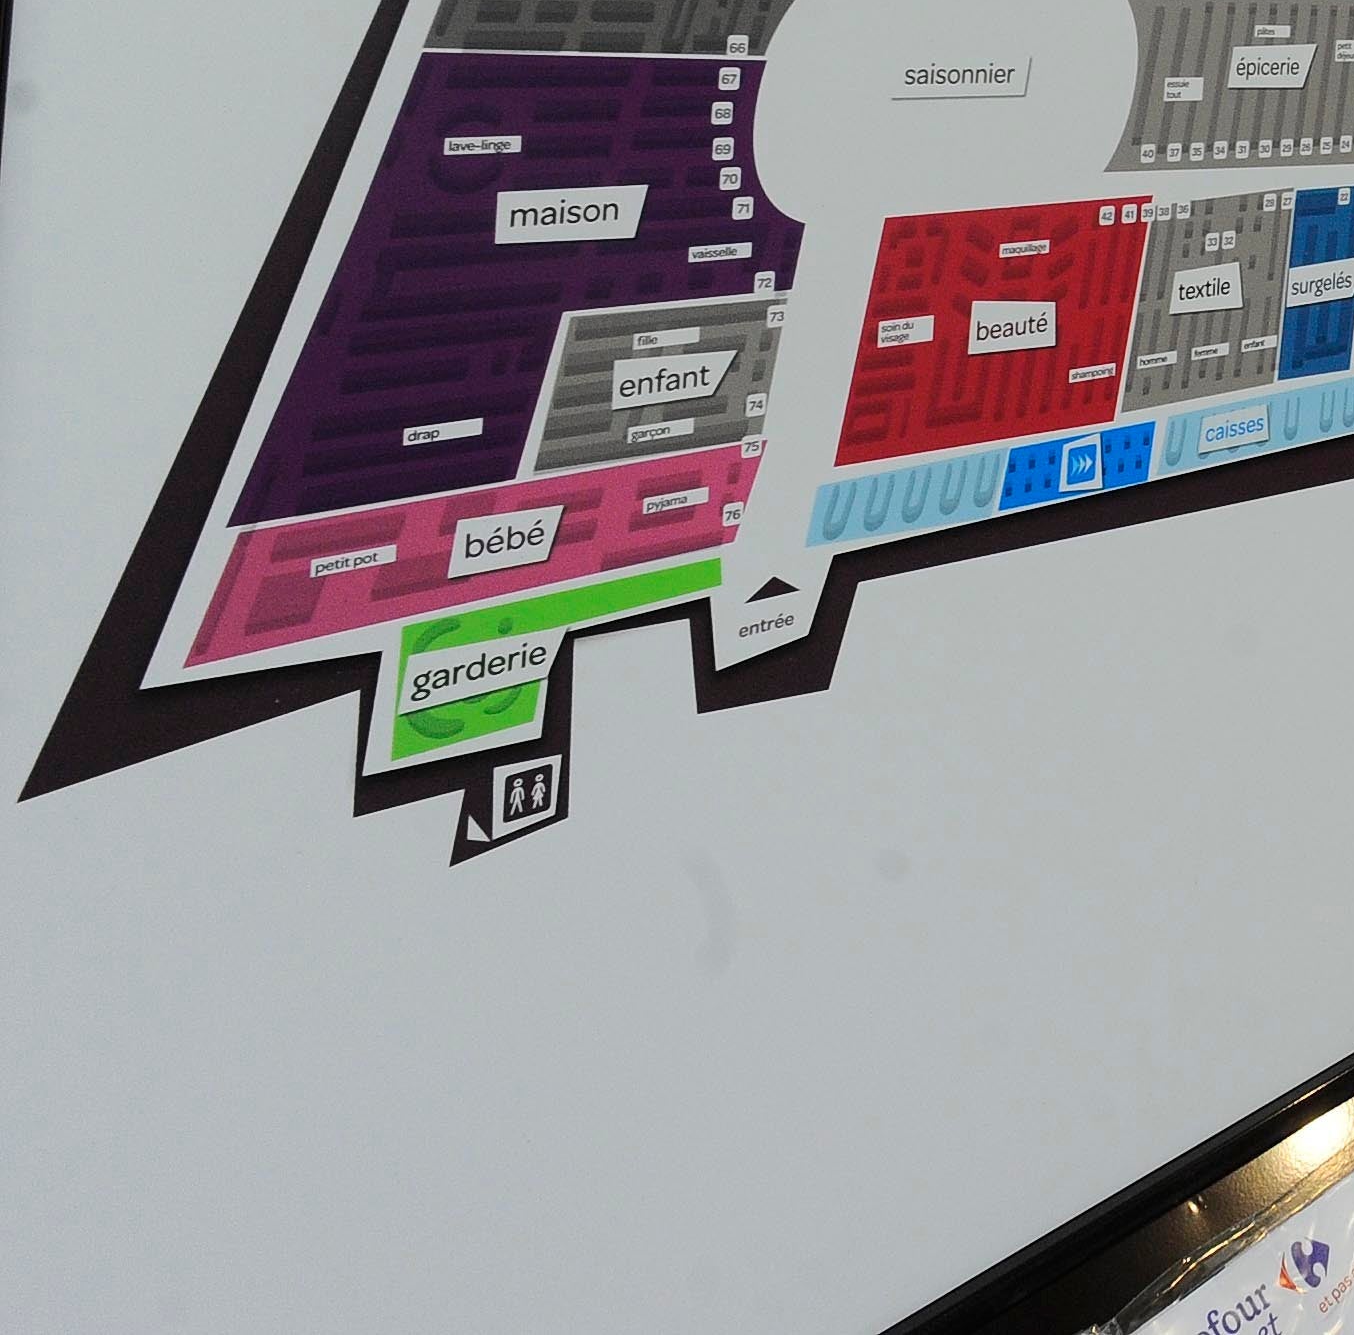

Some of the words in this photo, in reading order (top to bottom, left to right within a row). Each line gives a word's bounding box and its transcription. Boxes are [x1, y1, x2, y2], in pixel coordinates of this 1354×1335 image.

[729, 42, 746, 54] 66
[904, 61, 1016, 85] saisonnier
[1236, 57, 1300, 81] épicerie
[721, 74, 738, 85] 67
[714, 108, 732, 120] 68
[448, 139, 512, 153] lave-linge
[714, 144, 732, 155] 69
[722, 173, 739, 185] 70
[509, 198, 619, 228] maison
[737, 203, 750, 214] 71
[691, 246, 738, 259] vaisselle
[757, 277, 772, 289] 72
[1178, 276, 1231, 301] textile
[1291, 271, 1353, 298] surgelés
[769, 310, 785, 323] 73
[880, 322, 899, 333] soin
[900, 321, 915, 332] du
[975, 310, 1049, 342] beauté
[637, 333, 658, 347] fille
[1138, 354, 1168, 366] homme
[619, 364, 711, 397] enfant
[748, 398, 763, 411] 74
[407, 427, 440, 442] drap
[631, 424, 671, 443] garçon
[1205, 415, 1265, 442] caisses
[744, 440, 760, 454] 75
[645, 493, 688, 513] pyjama
[724, 508, 742, 522] 76
[464, 518, 546, 558] bébé
[314, 554, 350, 575] petit
[352, 550, 379, 570] pot
[738, 611, 795, 639] entrée
[411, 641, 548, 702] garderie
[1318, 1300, 1332, 1315] et
[1331, 1275, 1353, 1306] pas
